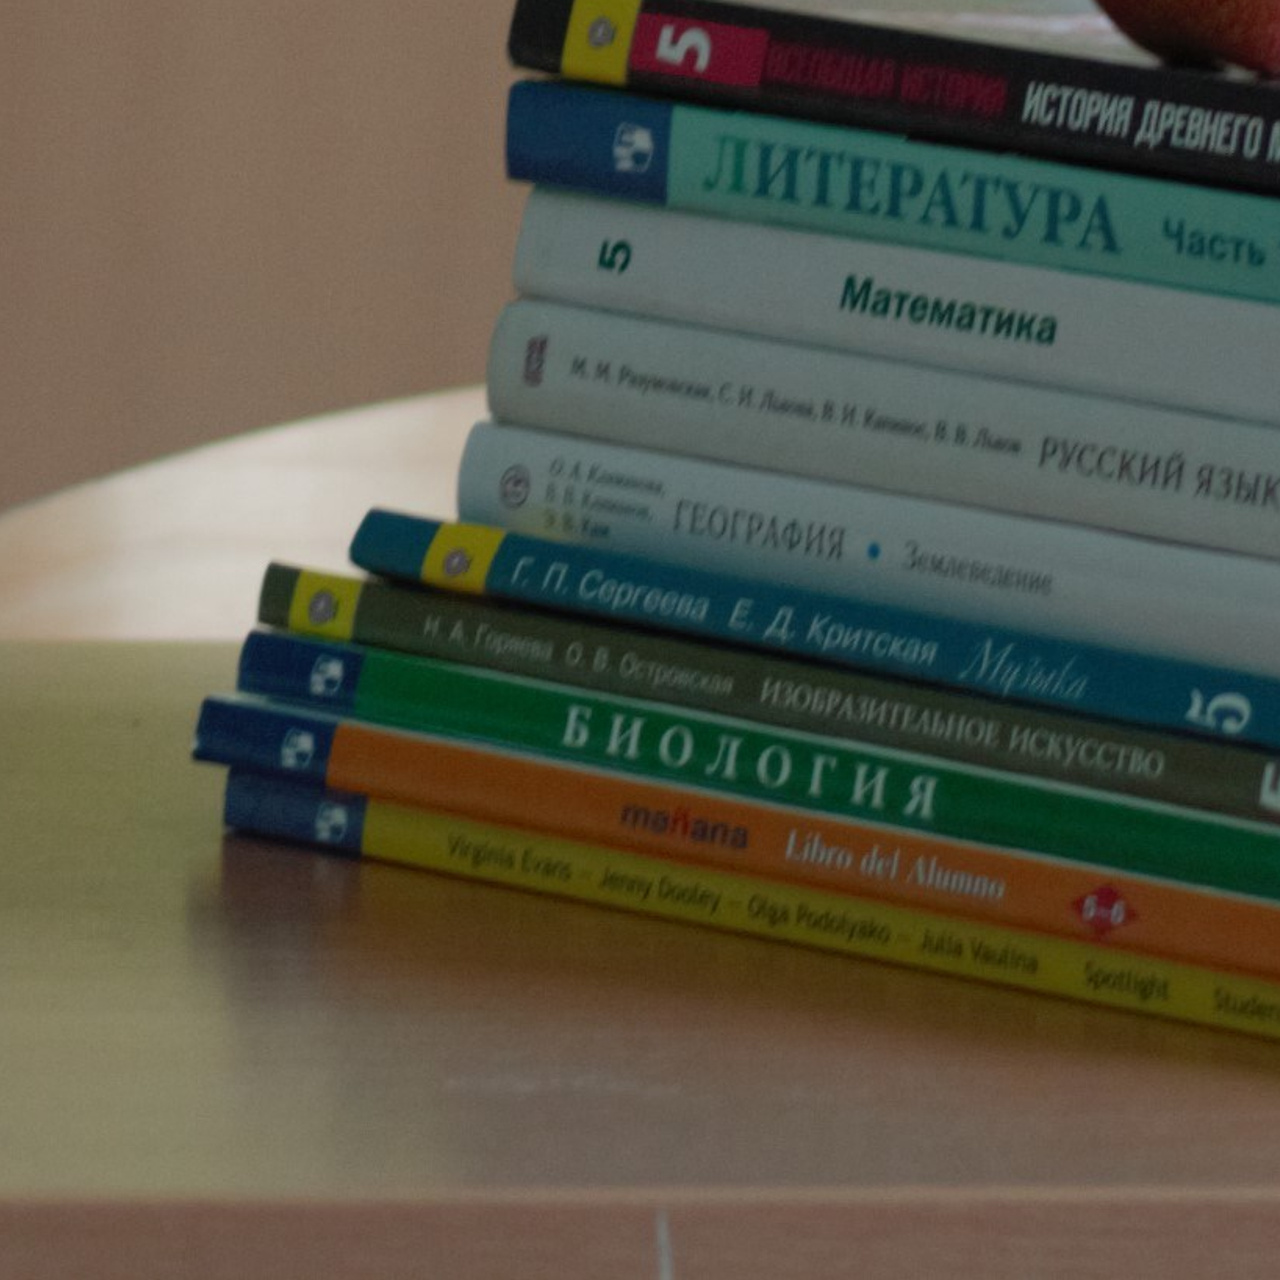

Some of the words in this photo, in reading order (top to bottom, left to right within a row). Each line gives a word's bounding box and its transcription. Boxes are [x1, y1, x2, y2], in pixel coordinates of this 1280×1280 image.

[657, 24, 711, 72] 5
[1022, 80, 1134, 139] ИСТОРИЯ
[1135, 100, 1265, 158] ДРЕВНЕГО
[703, 134, 1122, 256] ЛИТЕРАТУРА
[1162, 218, 1265, 268] Часть
[598, 240, 632, 274] 5
[840, 273, 1057, 345] Математика
[1039, 437, 1184, 499] РУССКИЙ
[673, 499, 845, 561] ГЕОГРАФИЯ
[903, 539, 1053, 597] Землеведение
[510, 555, 530, 583] Г.
[543, 567, 569, 598] П.
[577, 568, 709, 624] Сергеева
[728, 598, 755, 633] Е.
[765, 607, 797, 642] Д.
[806, 612, 939, 667] Критская
[956, 636, 1091, 700] Музыка
[760, 677, 1001, 748] ИЗОБРАЗИТЕЛЬНОЕ
[1008, 723, 1166, 778] ИСКУССТВО
[1186, 688, 1252, 735] 5
[562, 705, 939, 820] БИОЛОГИЯ
[620, 798, 749, 851] mañana
[784, 828, 853, 873] Libro
[859, 841, 900, 884] del
[907, 855, 1006, 902] Alumno
[448, 831, 515, 869] Virginia
[521, 847, 572, 883] Evans
[748, 893, 789, 927] Olga
[1084, 960, 1168, 1002] Spotlight
